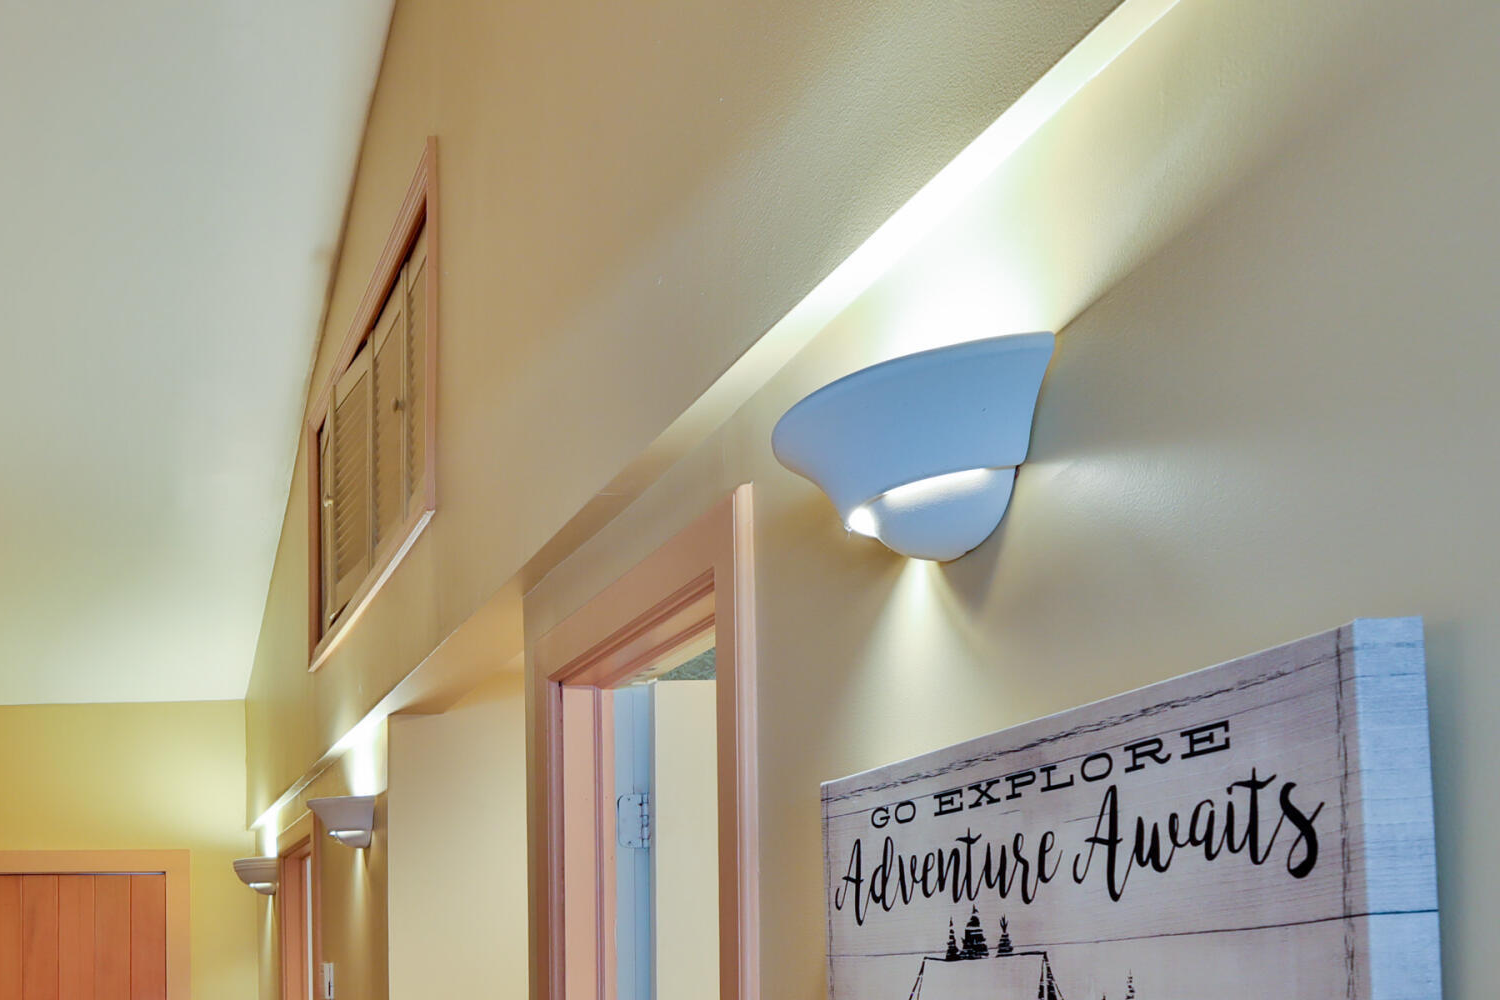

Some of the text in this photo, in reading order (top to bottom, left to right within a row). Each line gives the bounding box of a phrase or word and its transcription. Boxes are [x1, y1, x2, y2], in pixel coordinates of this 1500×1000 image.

[870, 719, 1231, 829] GO EXPLORE
[834, 765, 1326, 927] Adventure Awaits
